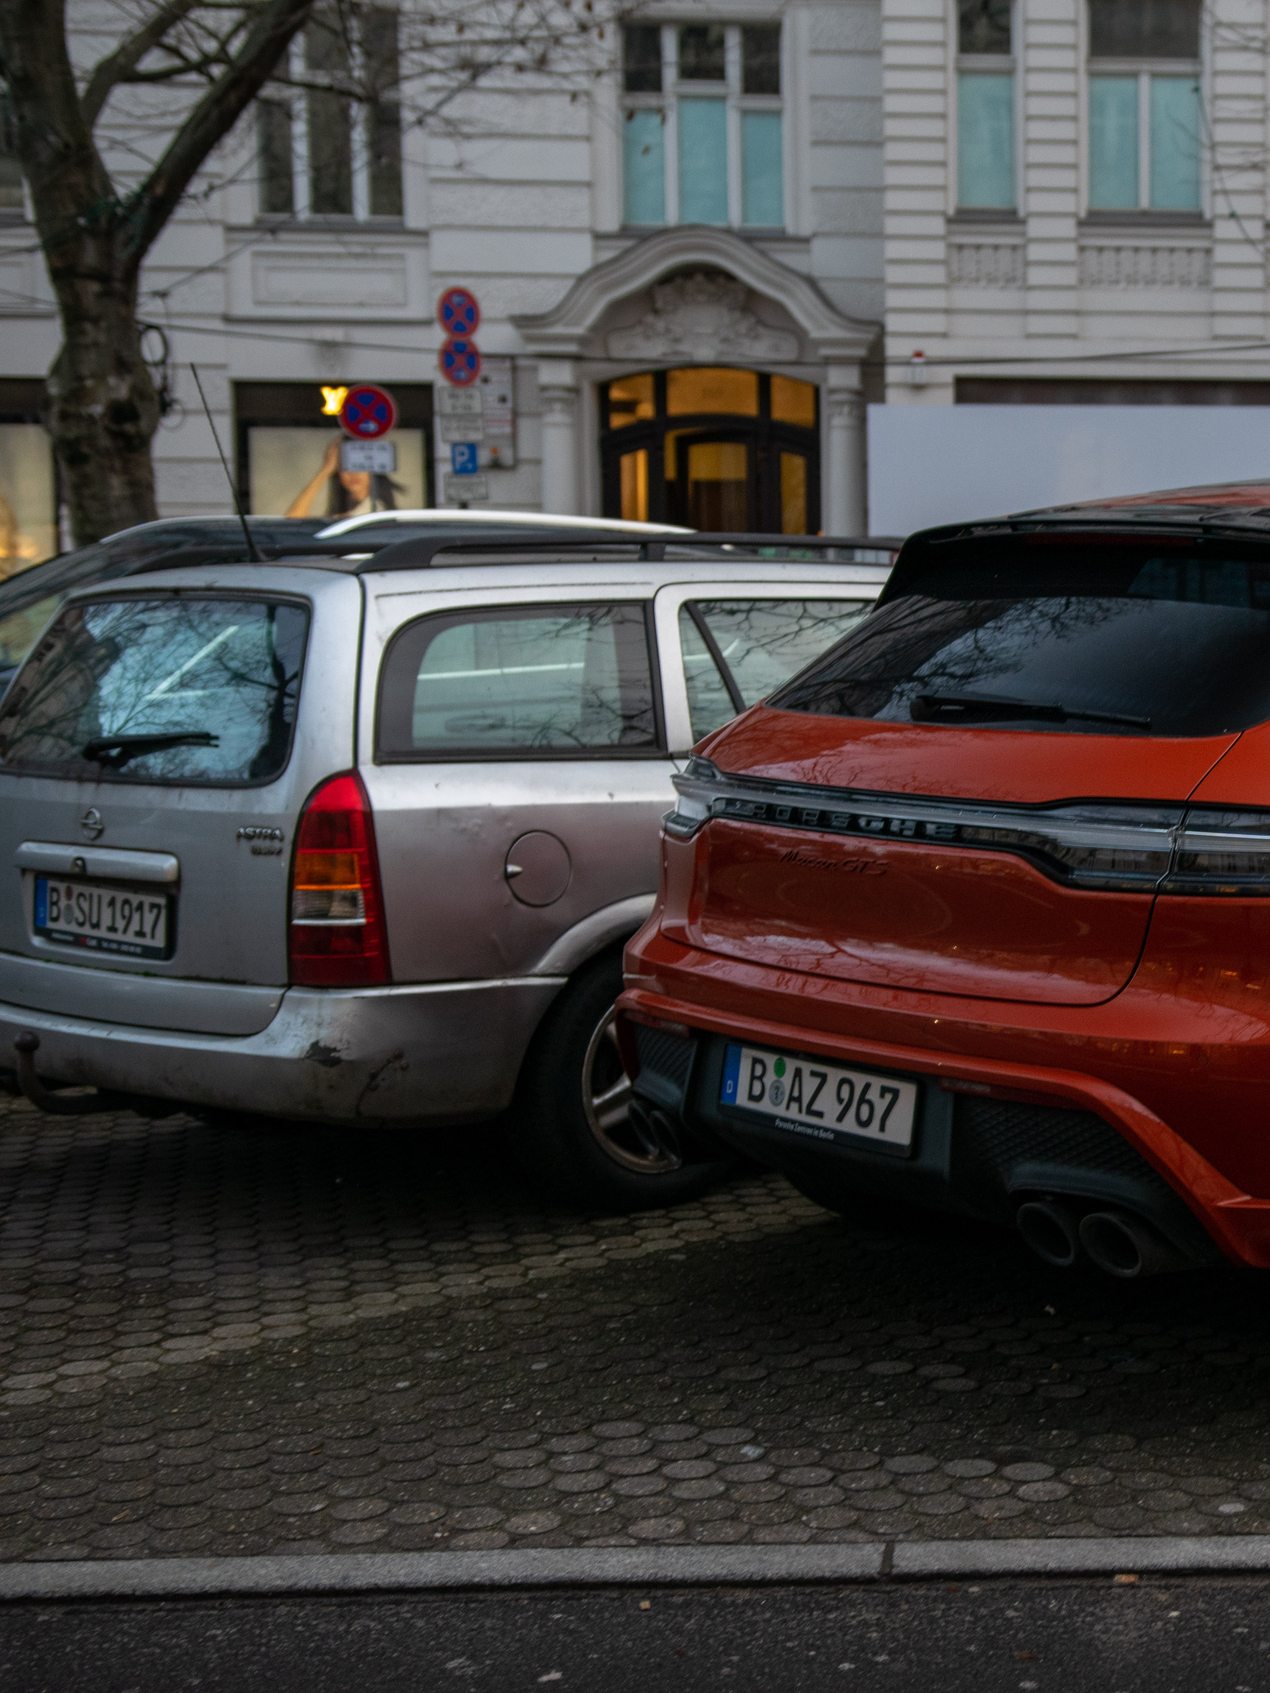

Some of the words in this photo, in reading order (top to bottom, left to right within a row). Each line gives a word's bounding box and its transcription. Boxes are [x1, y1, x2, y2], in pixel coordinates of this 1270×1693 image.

[748, 801, 957, 840] PORSCHE
[842, 856, 889, 876] GTS
[49, 886, 60, 922] B
[75, 891, 101, 930] SU
[106, 895, 162, 940] 1917
[747, 1056, 767, 1103] B
[785, 1067, 828, 1119] AZ
[835, 1076, 900, 1133] 967
